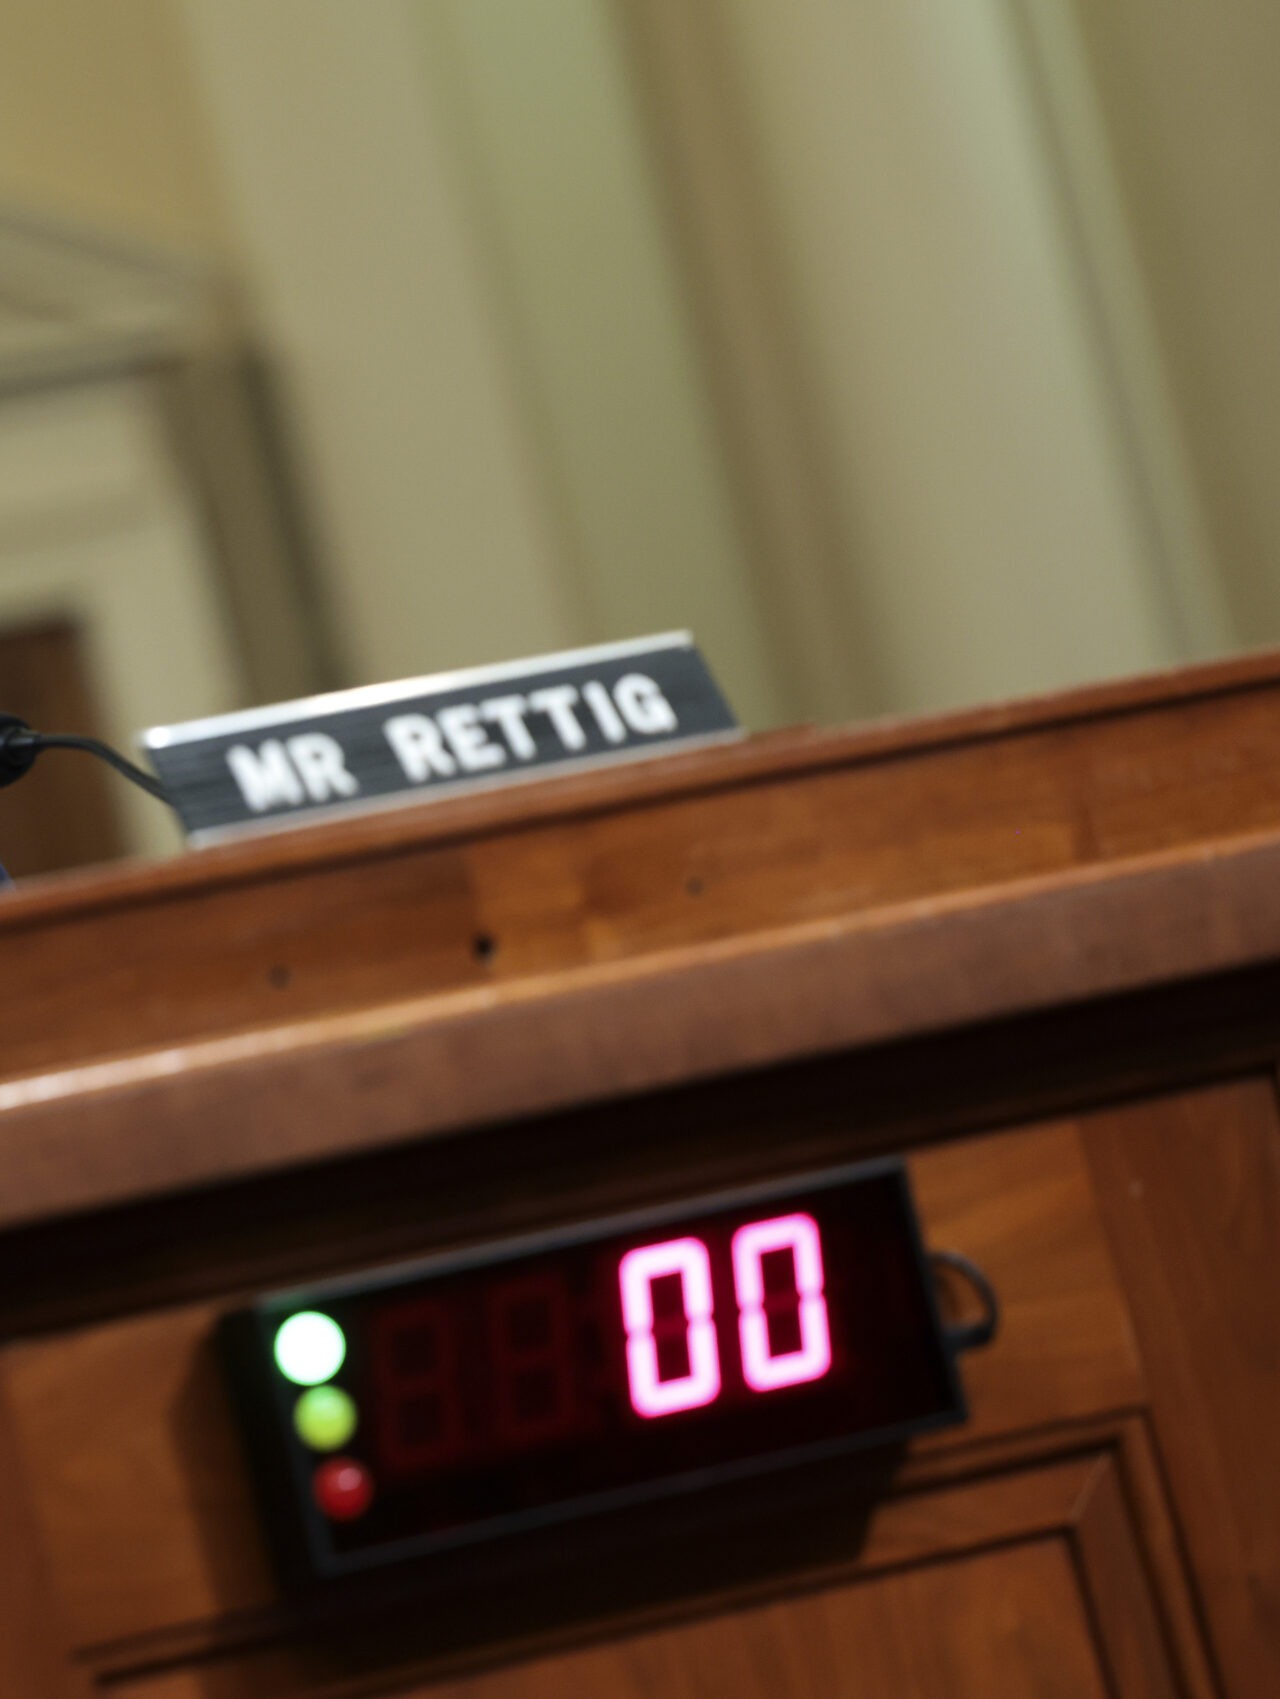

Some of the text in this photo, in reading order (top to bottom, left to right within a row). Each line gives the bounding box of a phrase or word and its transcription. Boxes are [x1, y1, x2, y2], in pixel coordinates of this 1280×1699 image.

[226, 673, 678, 812] MR RETTIG
[618, 1211, 832, 1418] 00
